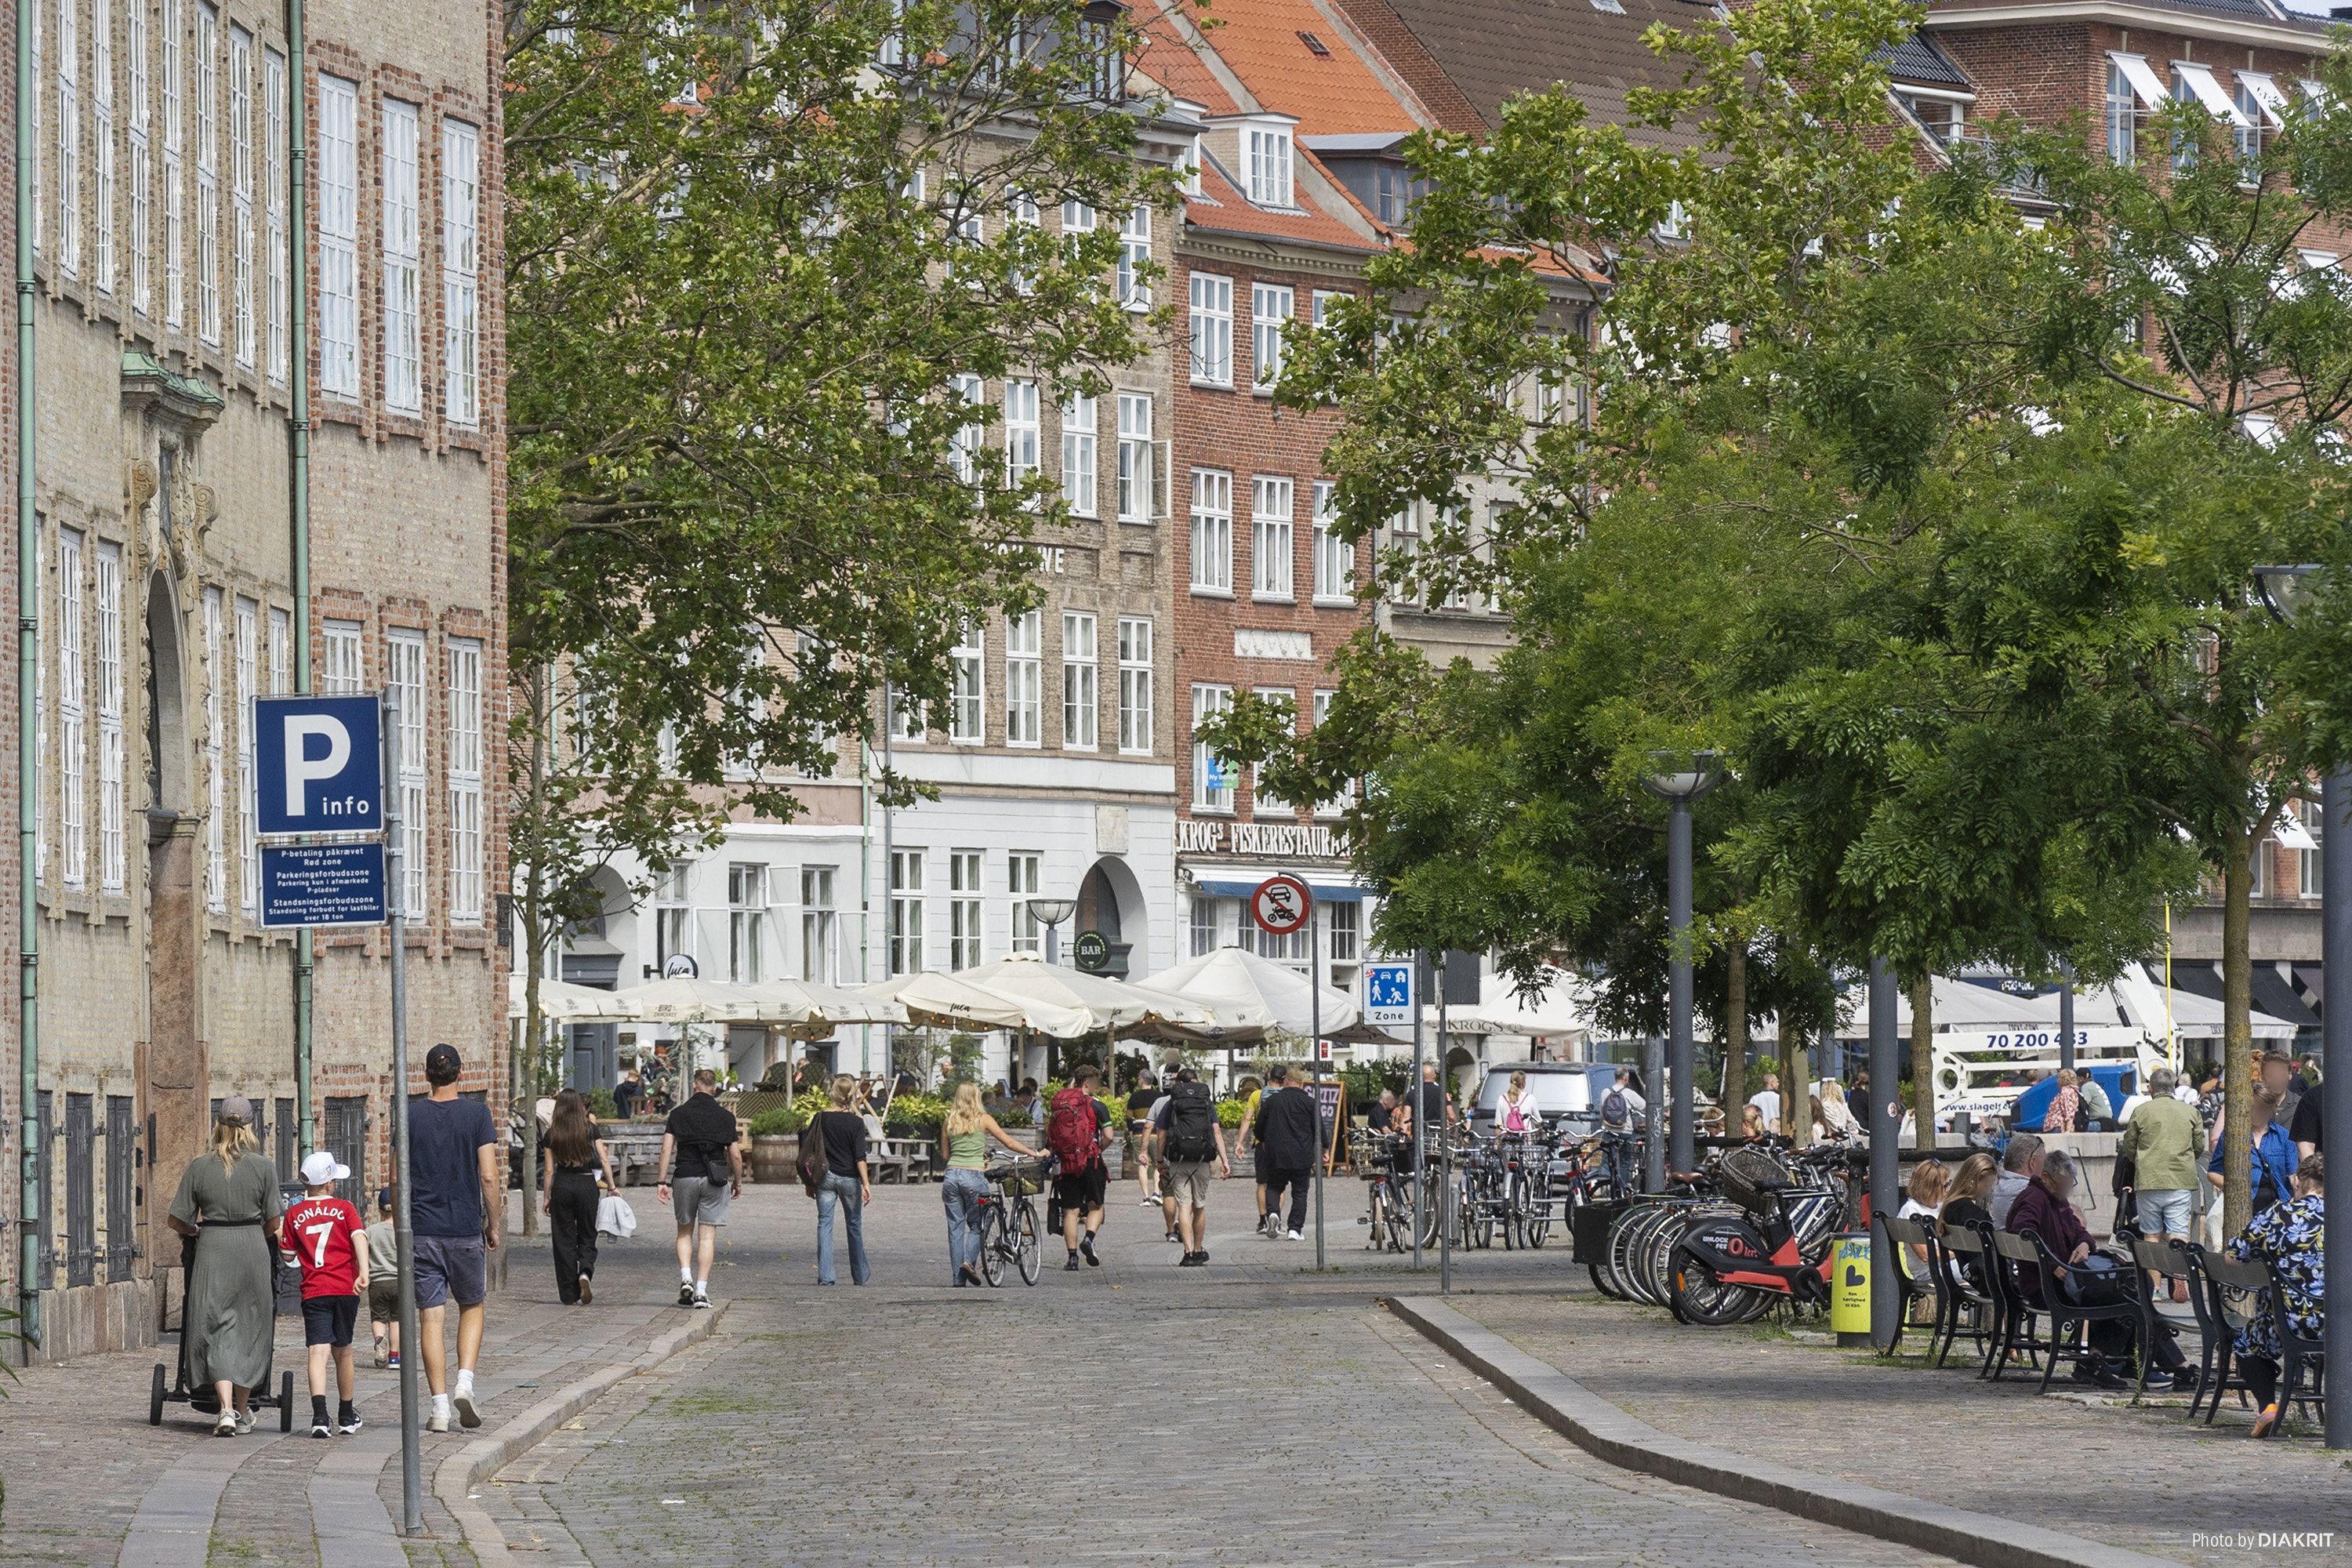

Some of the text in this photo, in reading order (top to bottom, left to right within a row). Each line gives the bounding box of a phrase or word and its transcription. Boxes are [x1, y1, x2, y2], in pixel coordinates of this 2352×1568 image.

[285, 714, 351, 816] P
[323, 797, 369, 815] info
[1230, 822, 1356, 857] FISKERESTAURAN
[326, 848, 364, 857] påkrævet
[277, 869, 369, 879] Parkeringsforbudszone
[274, 897, 374, 906] Standsningsforbudszone
[1081, 946, 1102, 955] BAR
[1375, 1011, 1403, 1020] Zone
[1447, 1019, 1504, 1033] KROGS
[1987, 1034, 2009, 1048] 70
[2014, 1033, 2049, 1047] 200
[1320, 1105, 1334, 1117] GO
[293, 1207, 345, 1230] RONALDO
[1802, 1216, 1827, 1243] RALEIGH
[306, 1221, 334, 1269] 7
[1744, 1246, 1759, 1258] kr.
